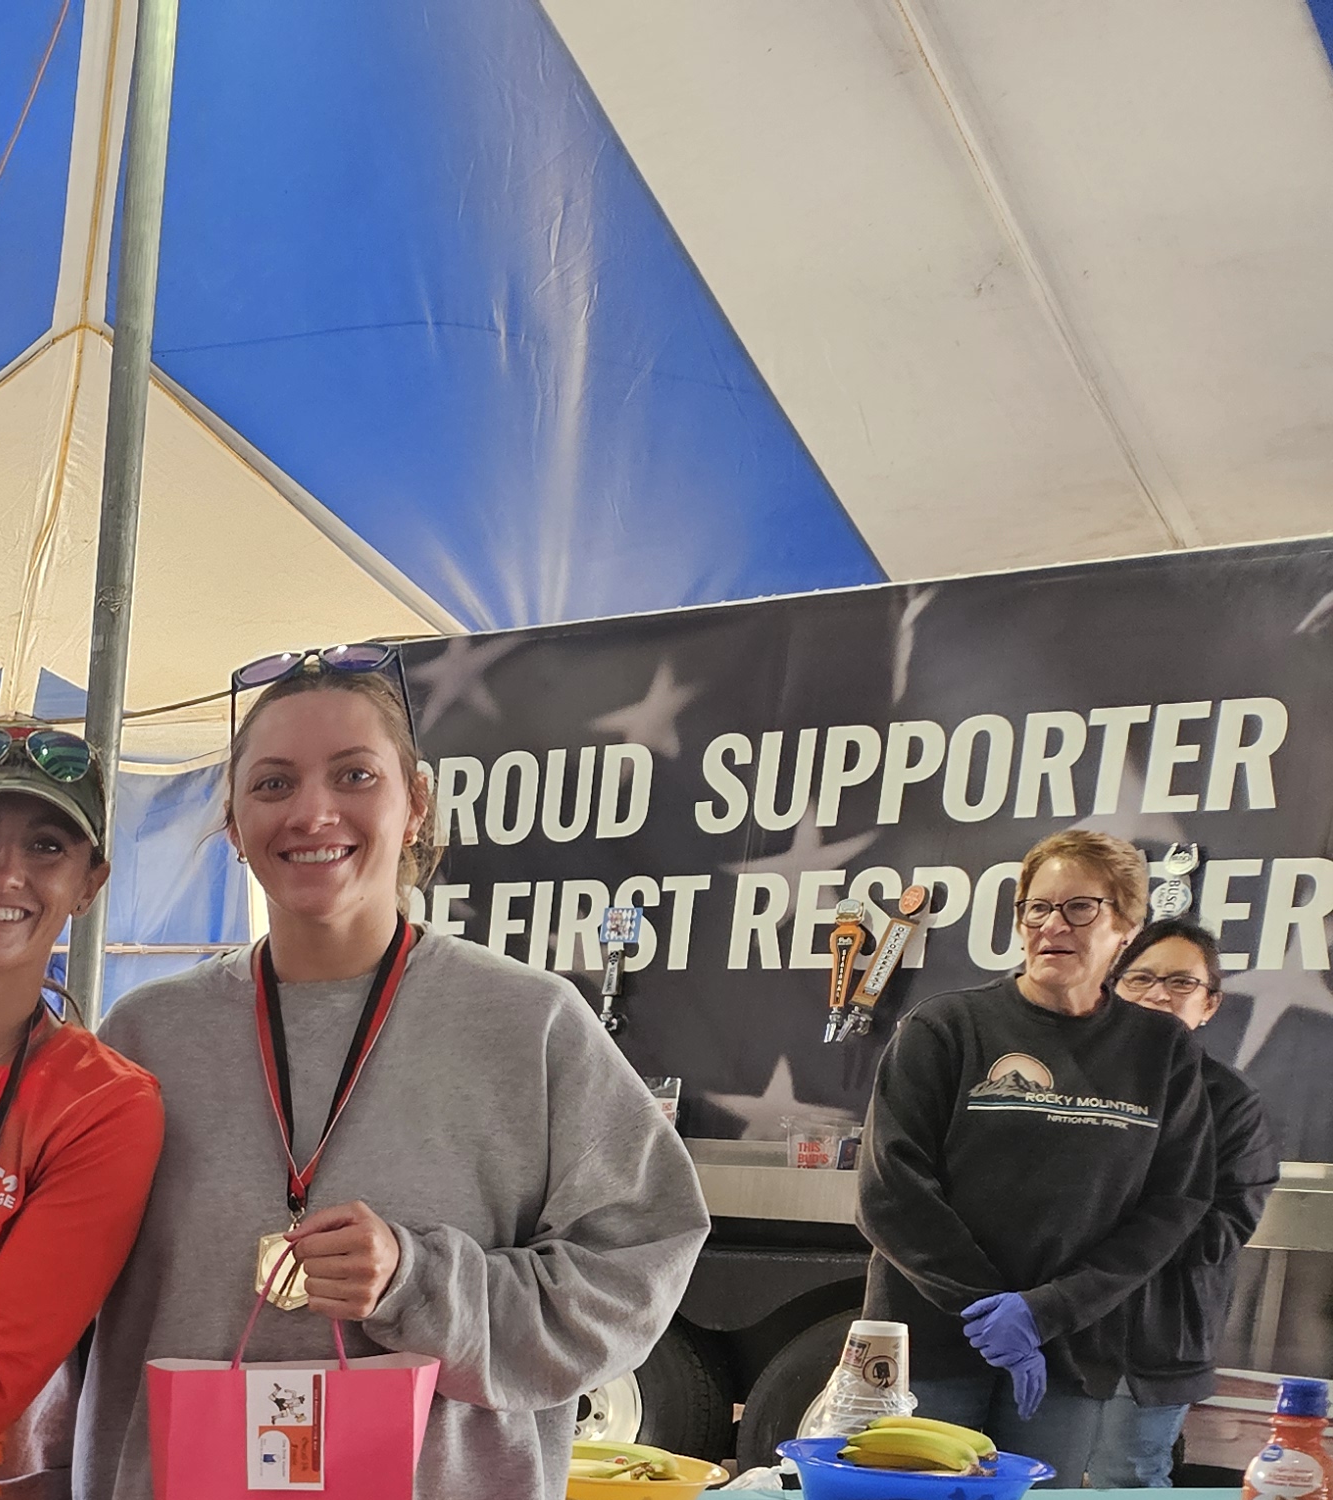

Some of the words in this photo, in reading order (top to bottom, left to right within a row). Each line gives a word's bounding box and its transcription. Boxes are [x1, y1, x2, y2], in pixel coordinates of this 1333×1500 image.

[417, 743, 653, 847] ROUD
[694, 697, 1288, 834] SUPPORTER
[489, 875, 712, 972] FIRST
[727, 857, 1333, 970] RESPOER
[1025, 1092, 1073, 1106] ROCKY
[1076, 1097, 1149, 1116] MOUNTAIN
[1047, 1114, 1100, 1125] NATIONAL
[1102, 1118, 1129, 1130] PARK
[797, 1142, 820, 1153] THIS
[797, 1153, 829, 1165] BUD'S
